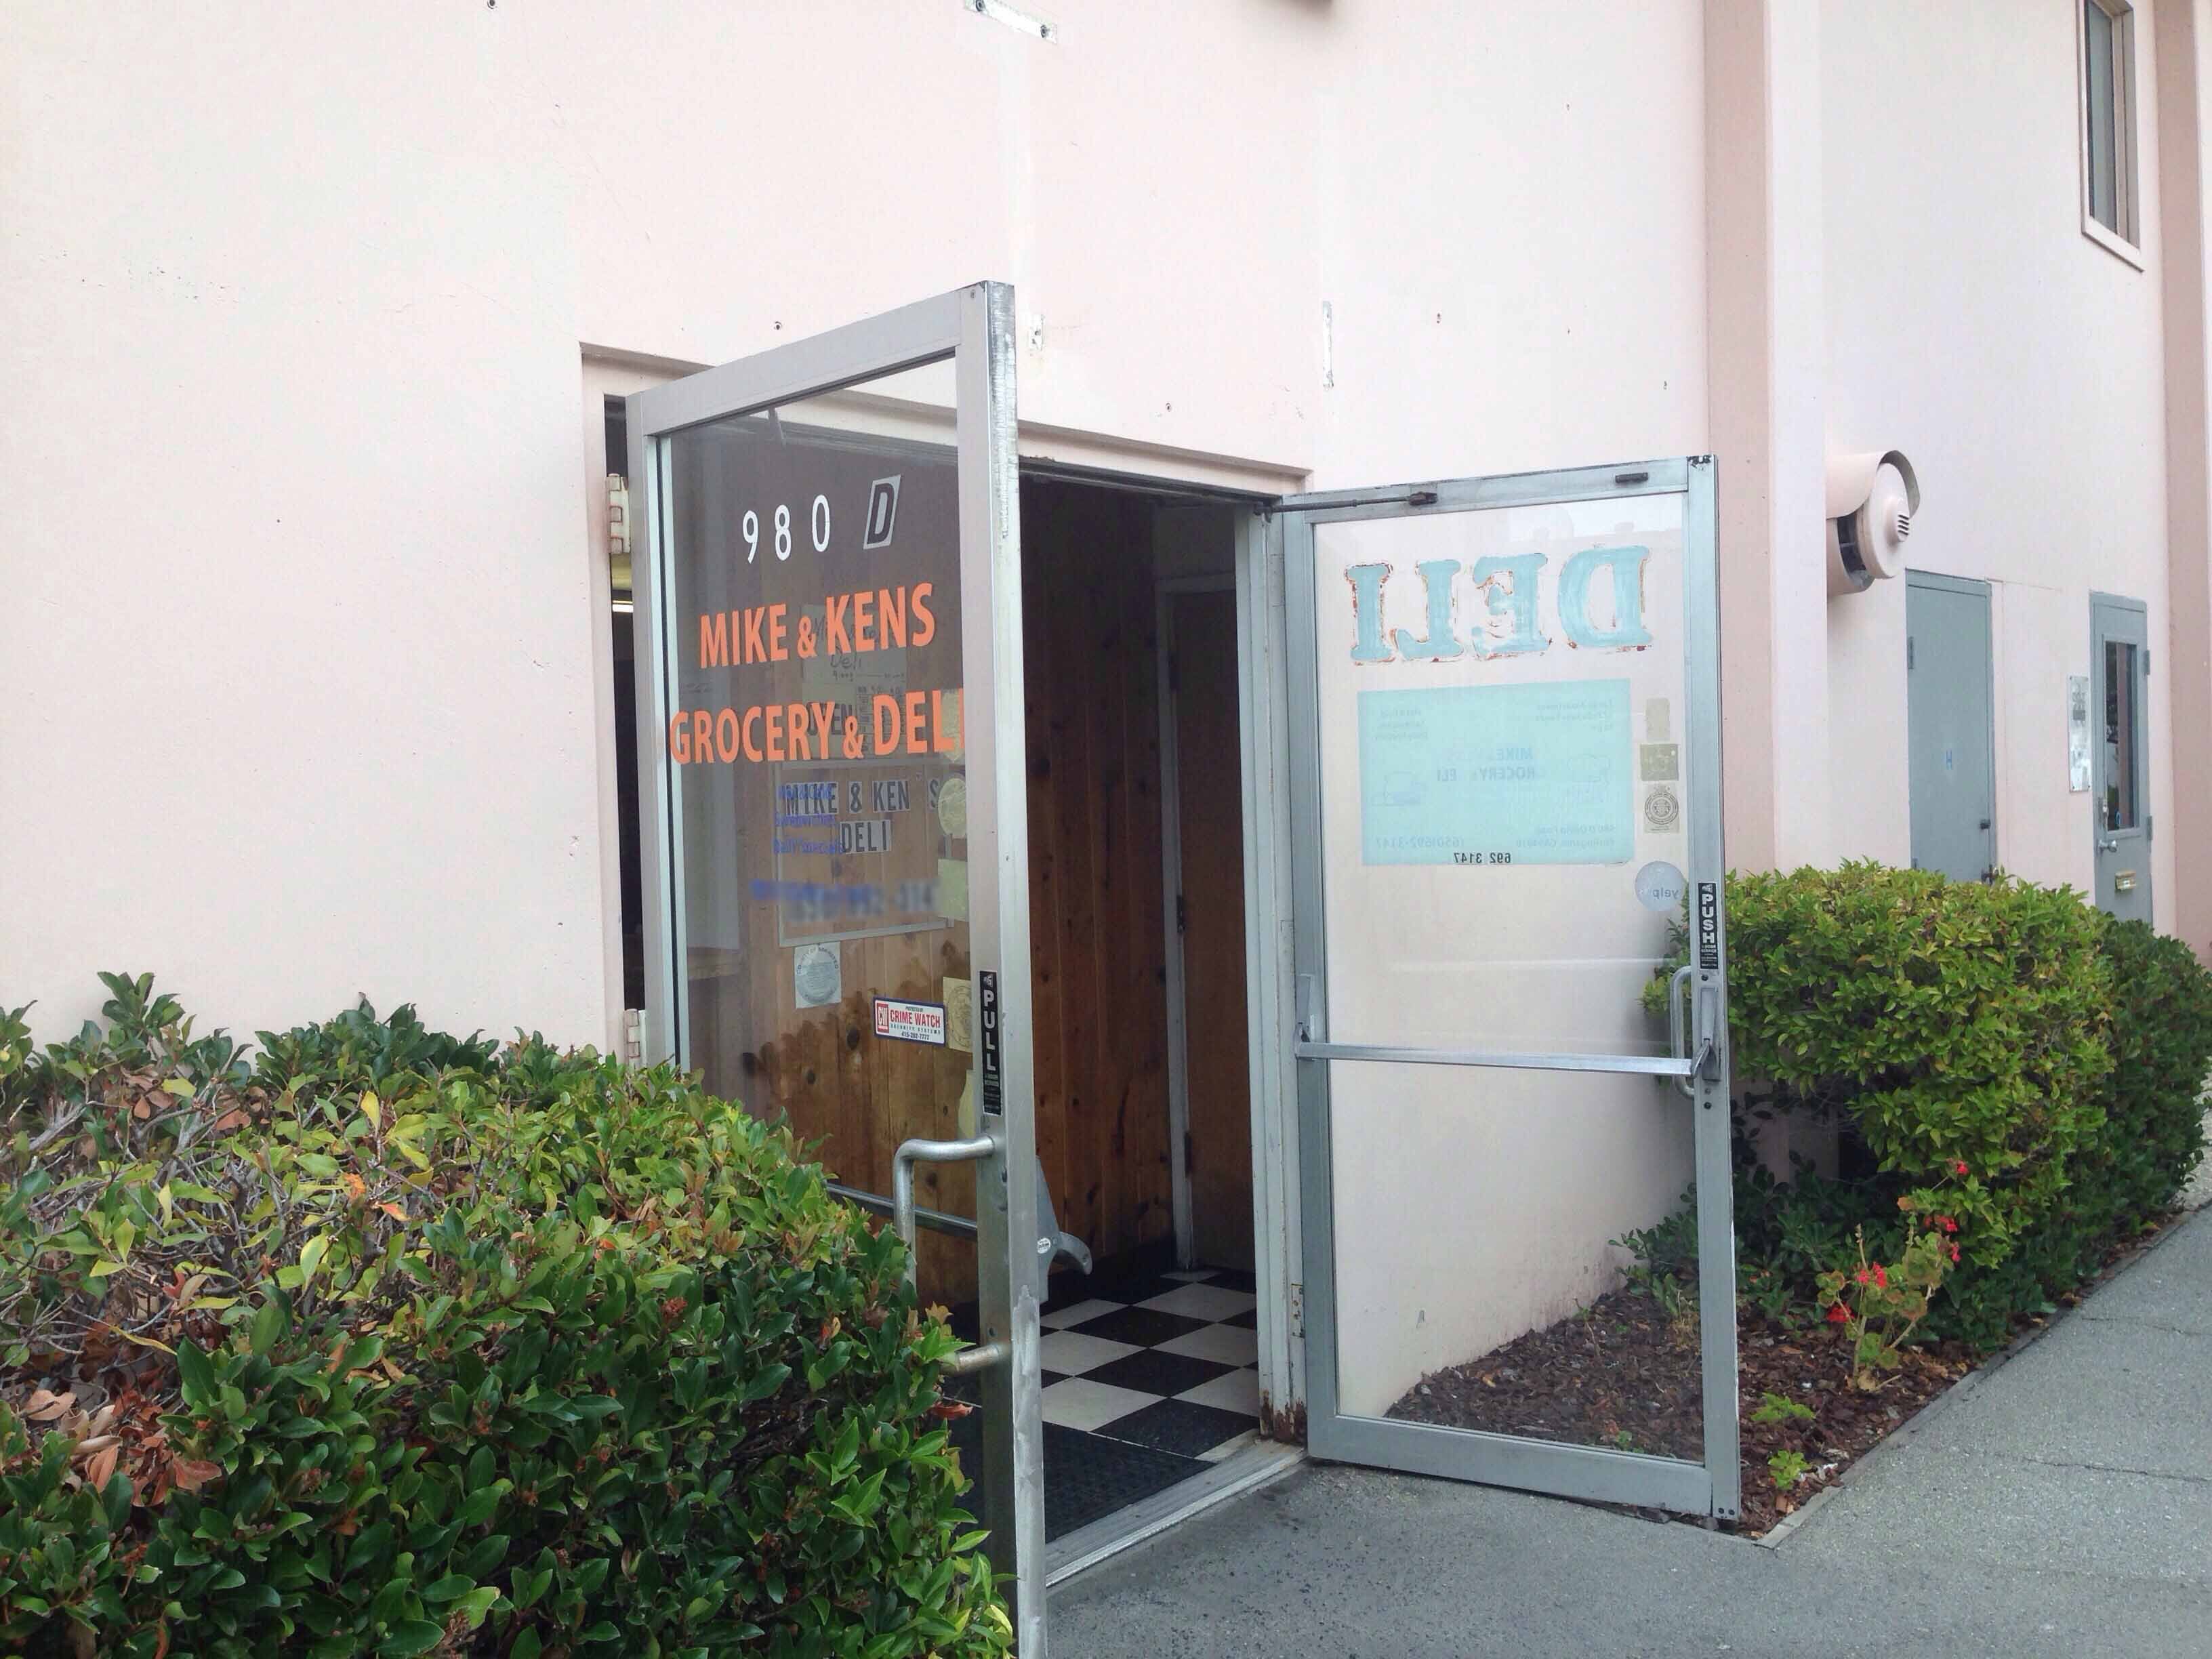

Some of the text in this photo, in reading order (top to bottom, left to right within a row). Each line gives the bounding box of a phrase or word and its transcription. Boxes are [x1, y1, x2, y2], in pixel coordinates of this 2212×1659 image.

[742, 493, 831, 565] 980
[699, 603, 788, 669] MIKE
[797, 615, 817, 659] &
[825, 581, 936, 655] KENS
[670, 700, 835, 765] GROCERY
[842, 715, 865, 760] &
[786, 782, 838, 815] MIKE
[850, 782, 863, 813] &
[841, 820, 888, 853] DELI
[1702, 894, 1715, 944] PUSH
[890, 1009, 941, 1029] CRIME WATCH
[983, 989, 996, 1071] PULL
